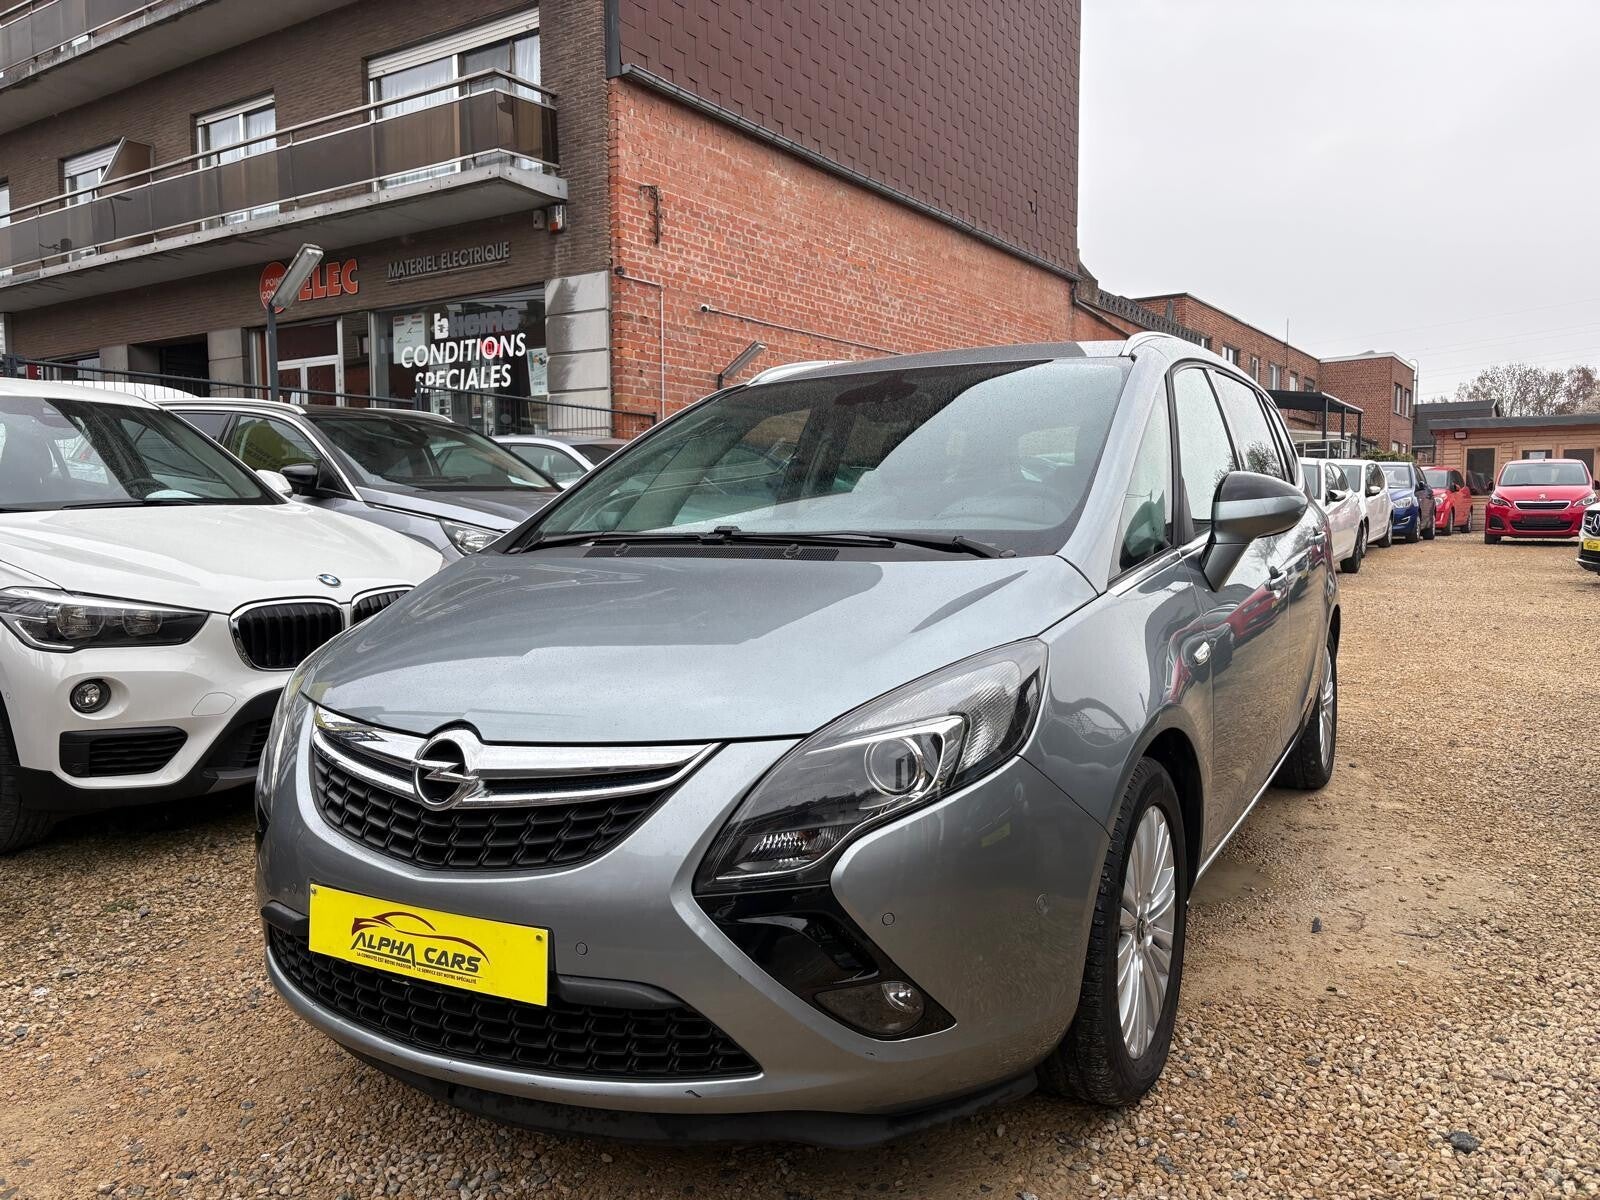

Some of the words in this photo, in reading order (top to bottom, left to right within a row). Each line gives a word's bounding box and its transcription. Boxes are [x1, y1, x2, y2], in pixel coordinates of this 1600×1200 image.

[388, 255, 438, 278] MATERIEL
[440, 241, 510, 269] ELECTRIQUE
[401, 332, 527, 369] CONDITIONS
[414, 363, 512, 394] SPECIALES
[350, 932, 416, 967] ALPHA
[423, 947, 481, 973] CARS
